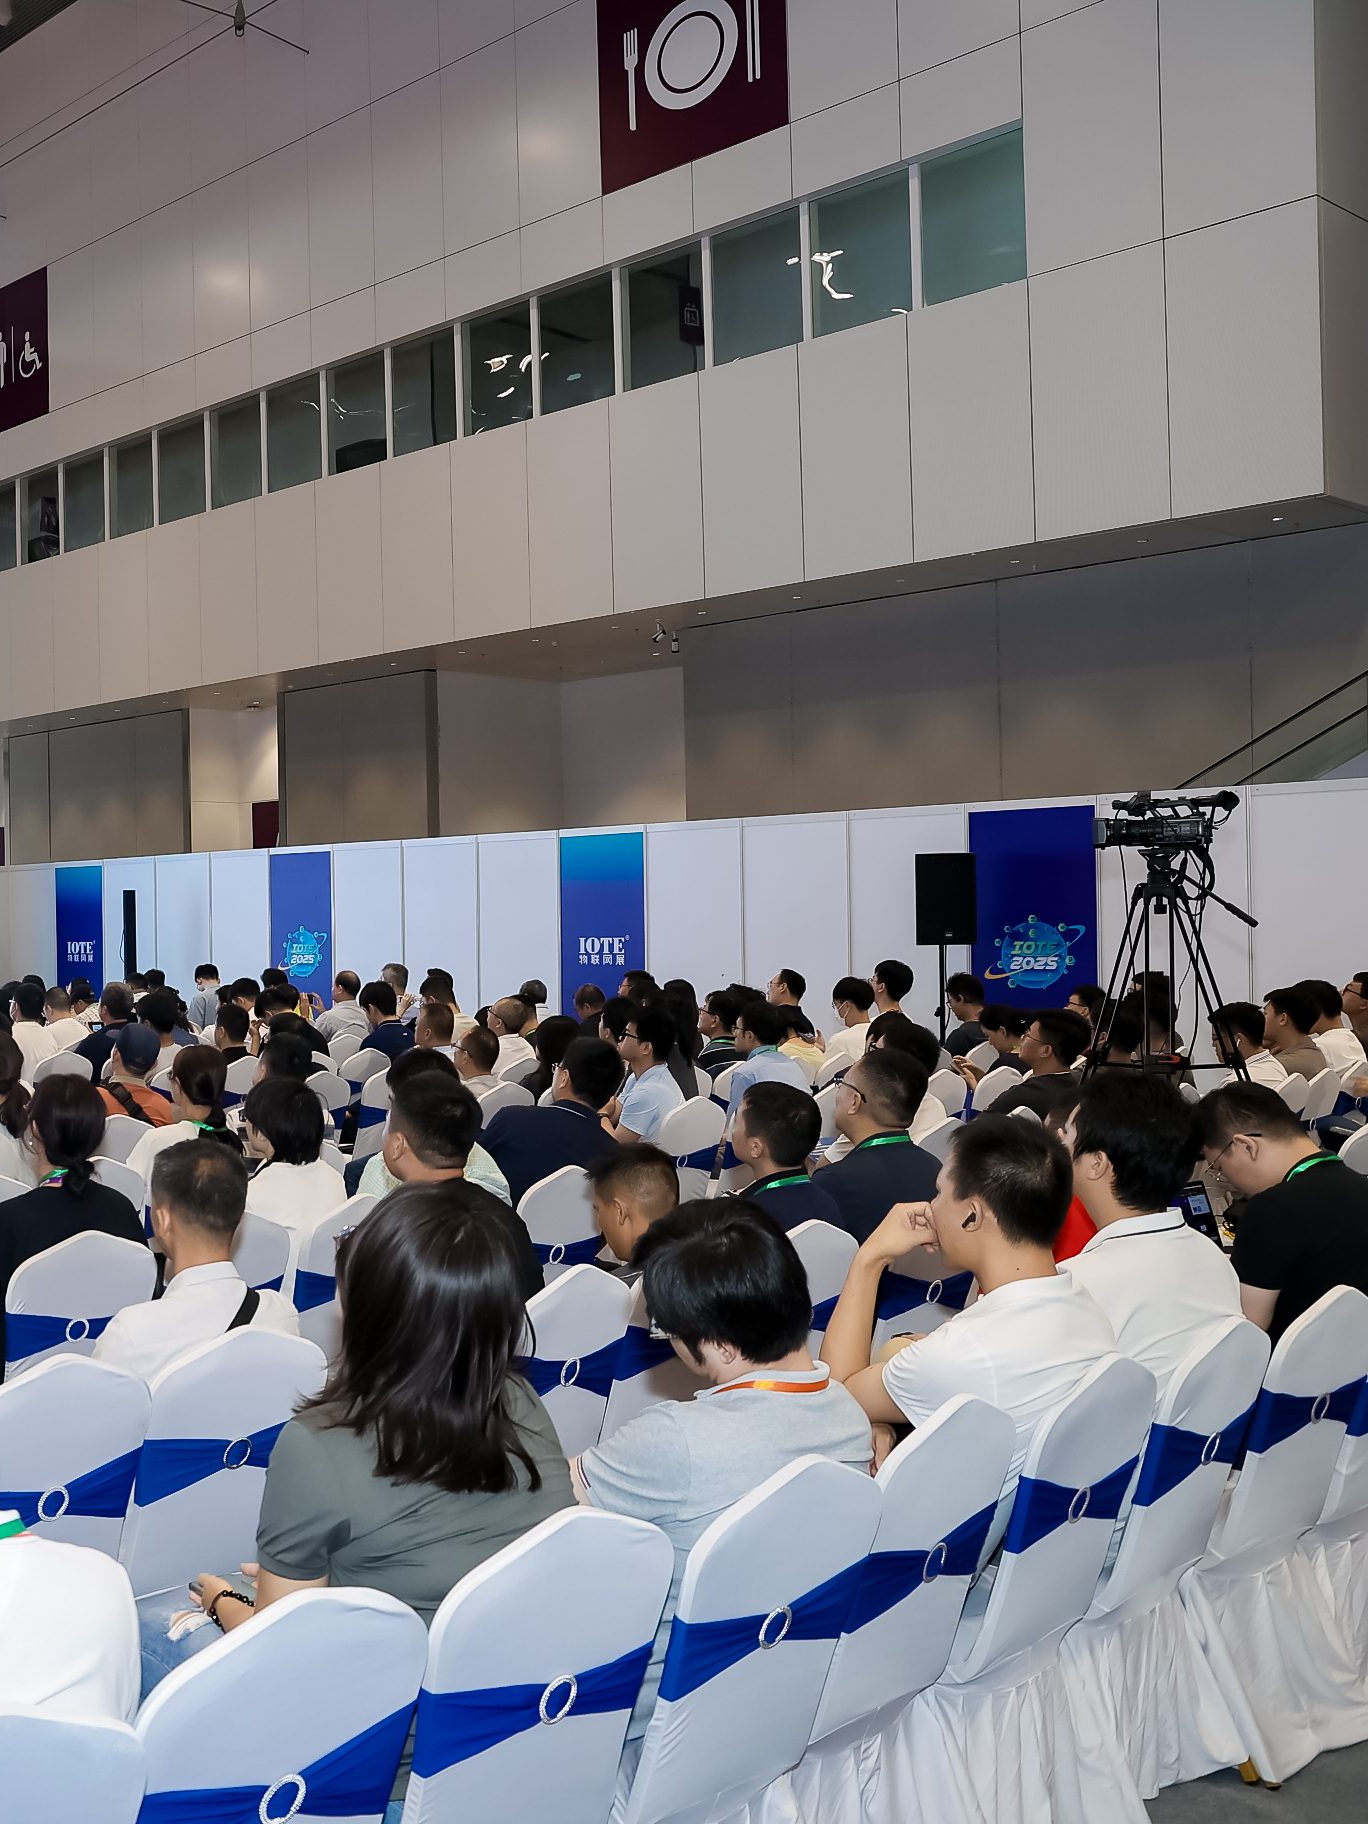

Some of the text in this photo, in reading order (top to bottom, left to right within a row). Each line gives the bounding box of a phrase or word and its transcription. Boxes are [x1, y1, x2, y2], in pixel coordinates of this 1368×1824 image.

[67, 941, 94, 954] IOTE
[290, 943, 315, 954] IOTE
[1011, 941, 1058, 955] IOTE
[290, 954, 316, 964] 2025
[578, 954, 625, 966] 物联网展
[1009, 956, 1060, 970] 2025
